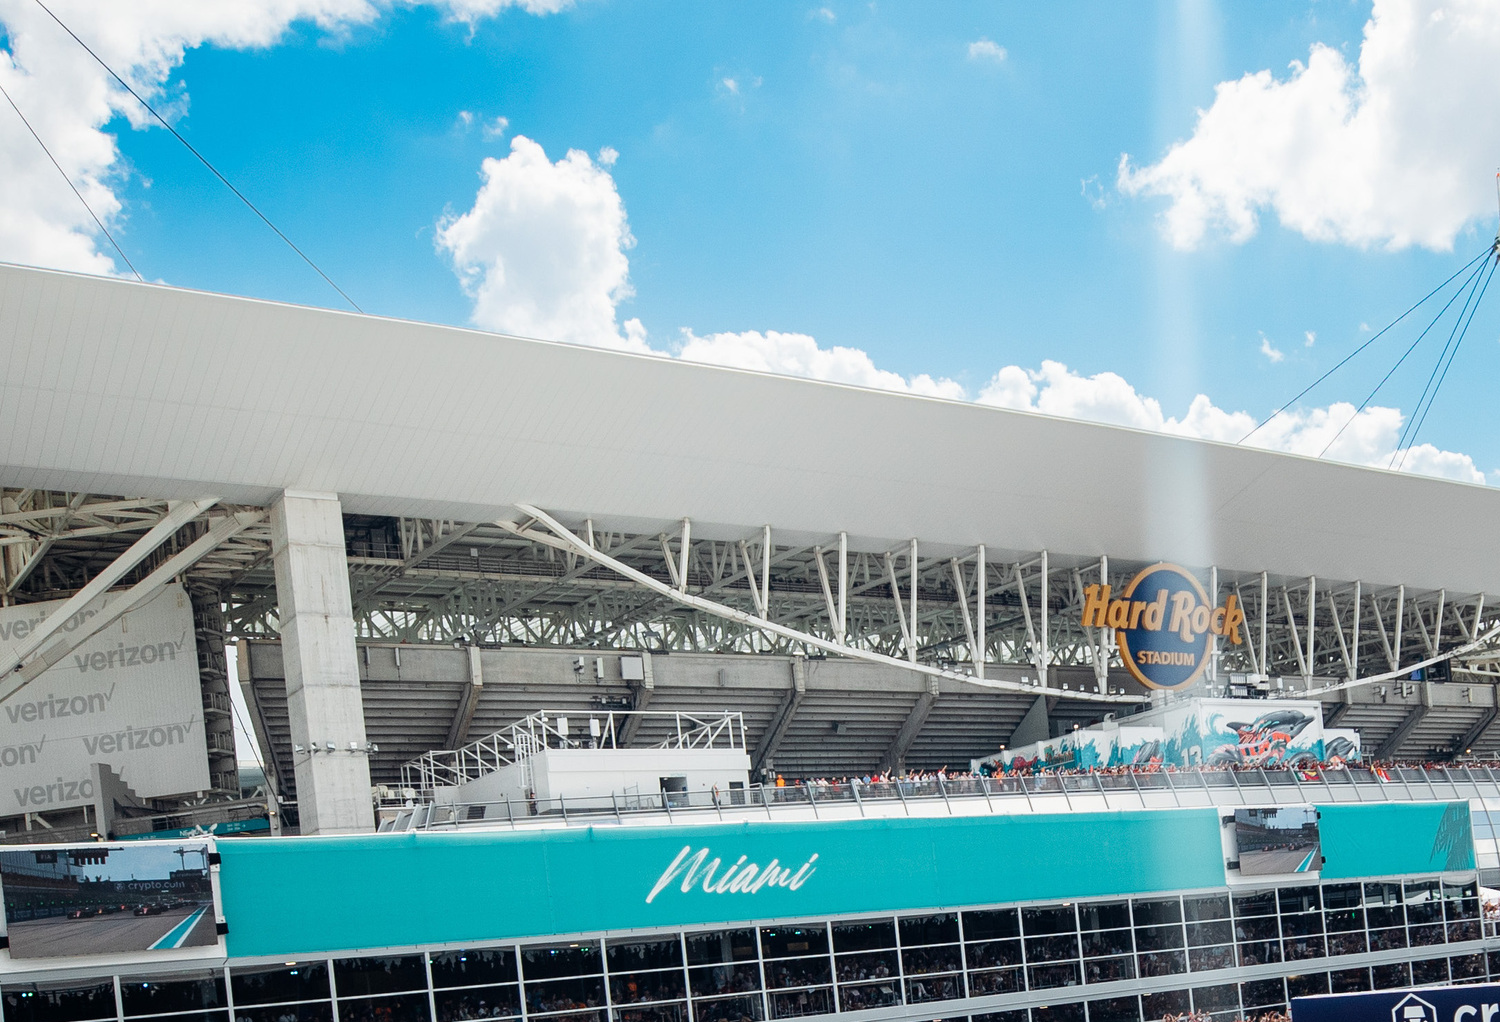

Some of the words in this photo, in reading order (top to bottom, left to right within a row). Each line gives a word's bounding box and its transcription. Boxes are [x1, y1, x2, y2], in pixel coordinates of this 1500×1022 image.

[1, 600, 98, 642] verion
[1081, 583, 1169, 632] Hard
[1168, 589, 1244, 645] Rock
[74, 641, 175, 673] verizon
[1137, 650, 1195, 667] STADIUM
[5, 691, 105, 724] verizon
[83, 724, 184, 756] verizon
[14, 778, 94, 807] verizo
[646, 845, 818, 904] Miami
